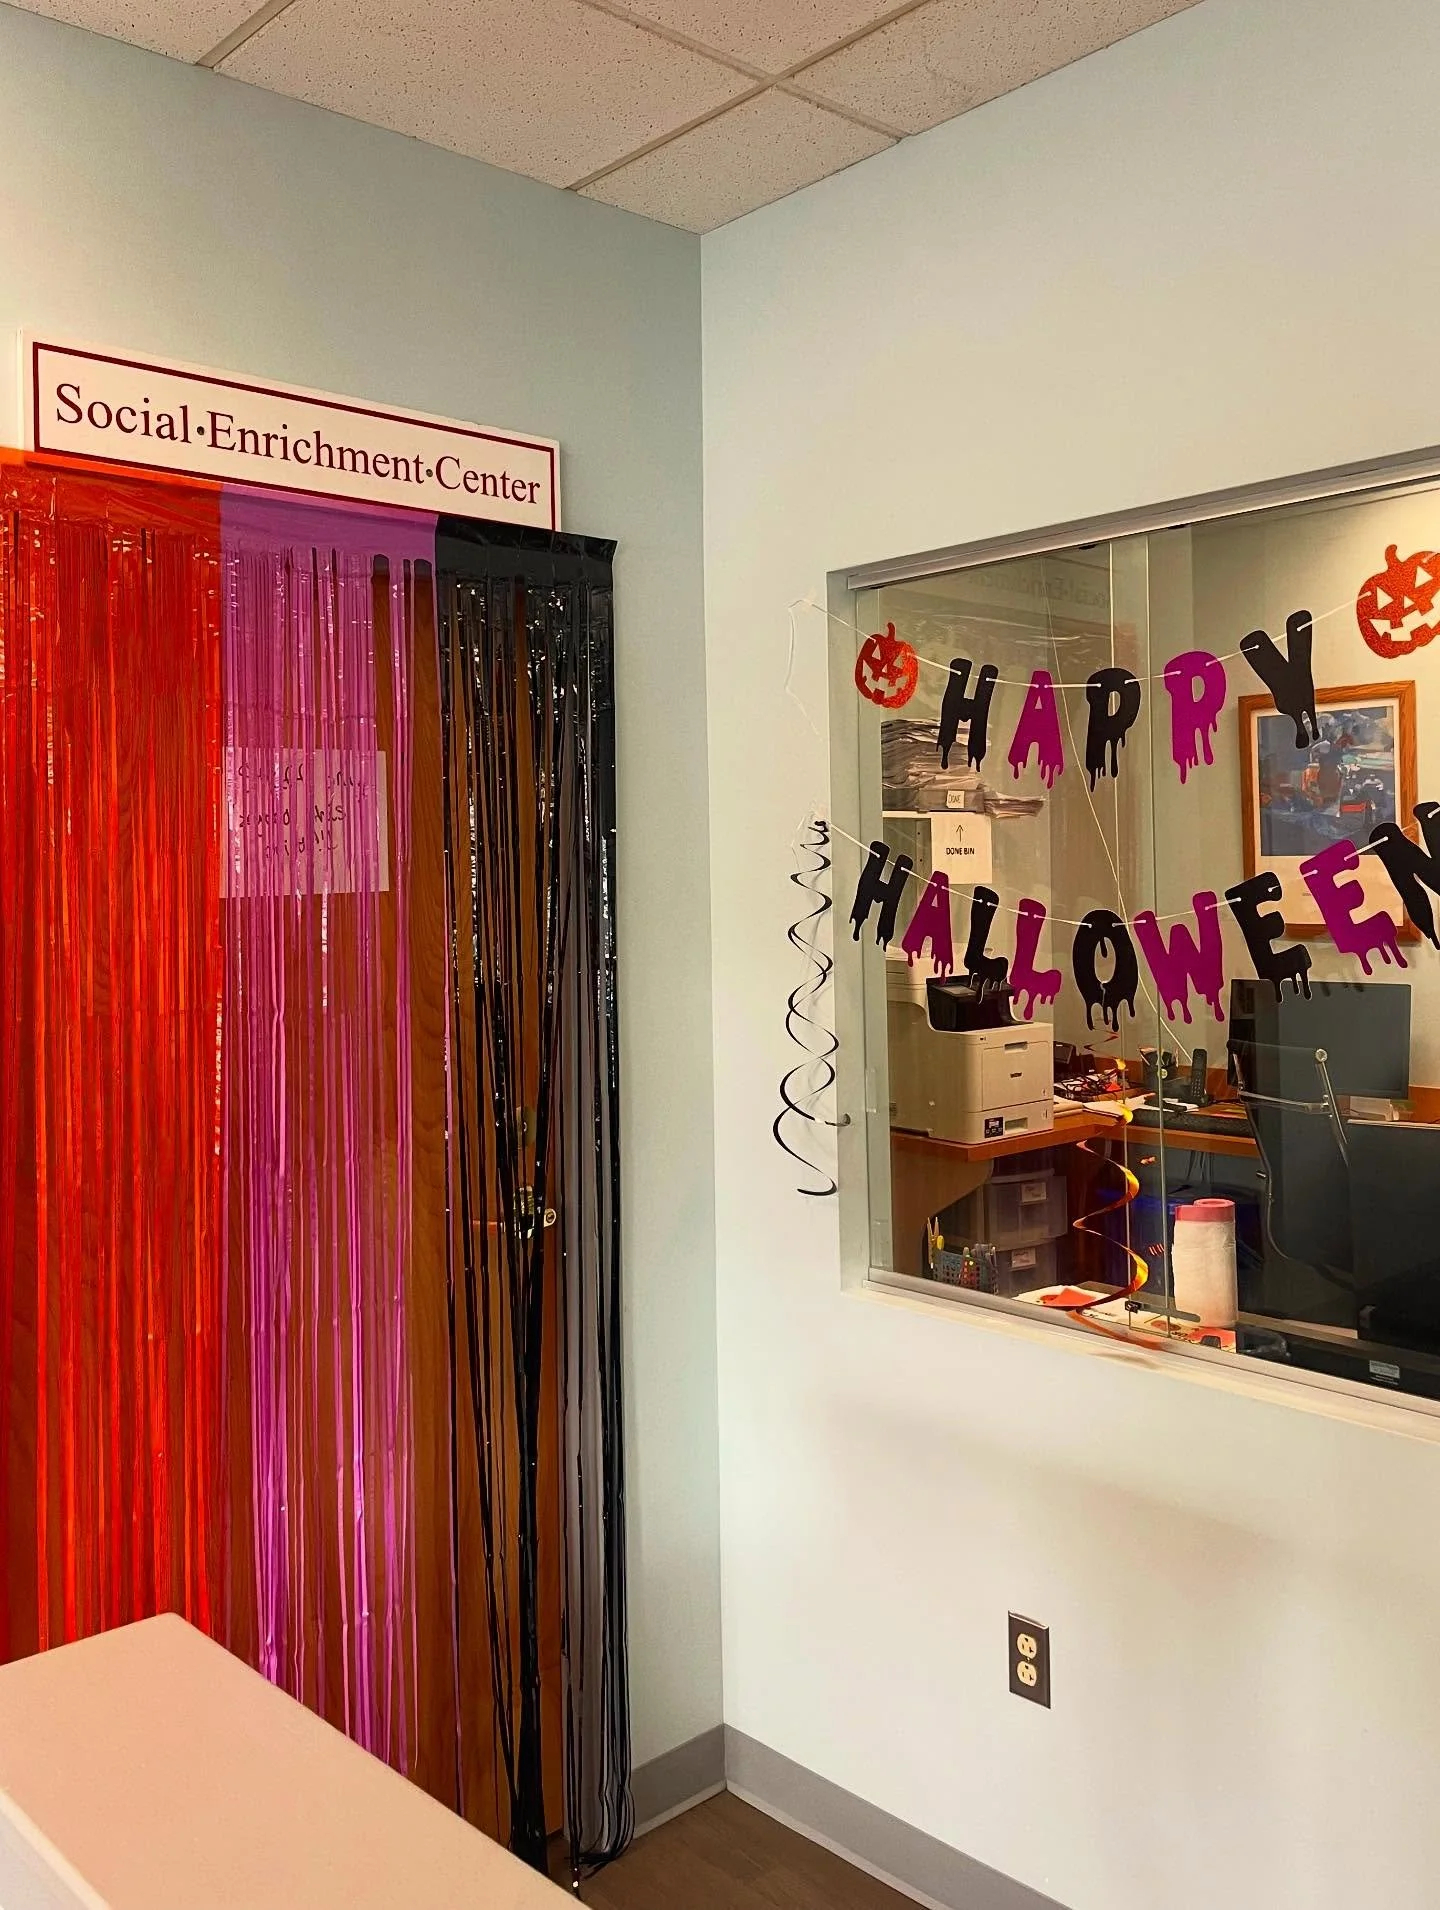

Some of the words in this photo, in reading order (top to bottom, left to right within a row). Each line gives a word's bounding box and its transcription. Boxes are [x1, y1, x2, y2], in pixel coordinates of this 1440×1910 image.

[936, 610, 1320, 793] HAPPY
[946, 847, 962, 856] DONE
[963, 847, 975, 856] BIN
